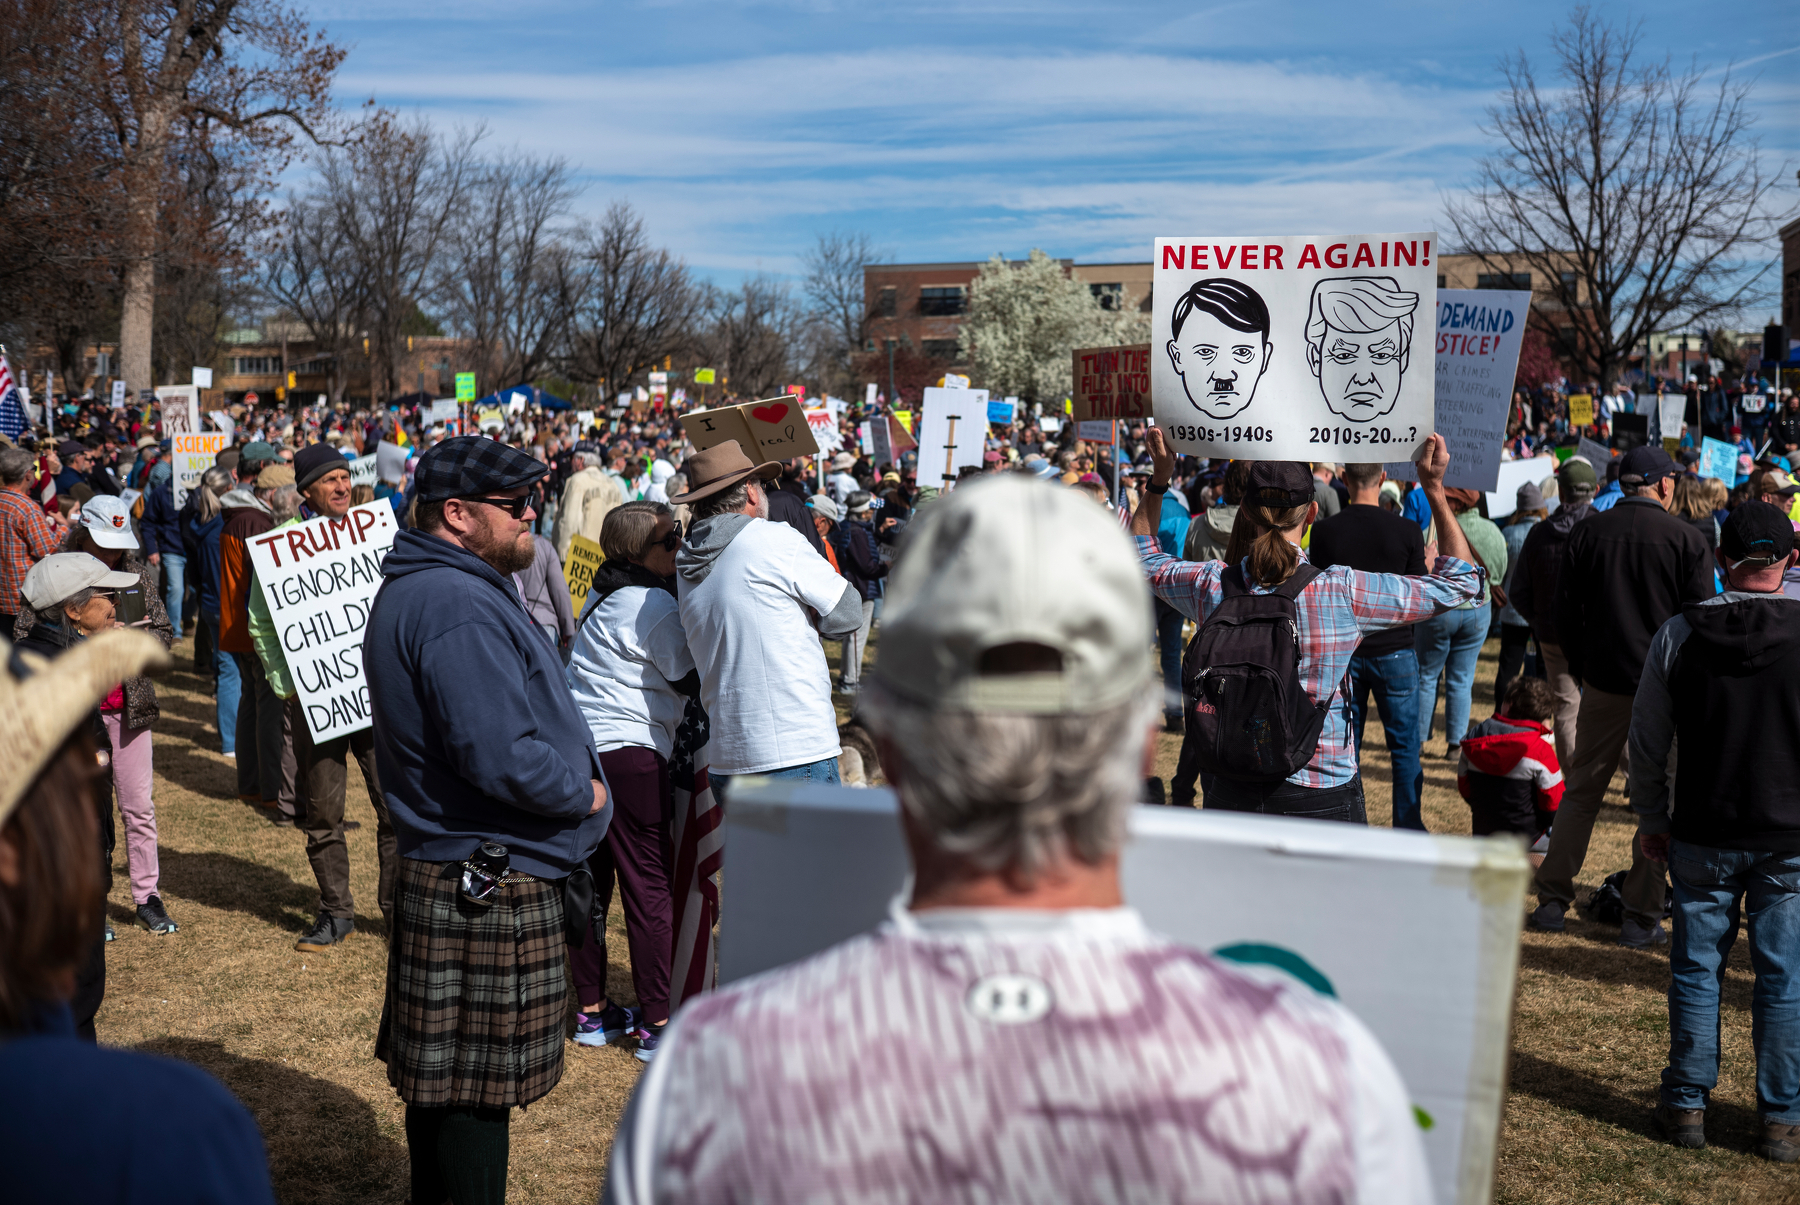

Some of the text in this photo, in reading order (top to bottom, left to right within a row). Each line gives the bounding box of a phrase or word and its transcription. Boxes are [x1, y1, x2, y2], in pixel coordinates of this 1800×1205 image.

[1162, 240, 1431, 270] NEVER AGAIN!
[1440, 302, 1514, 333] DEMAND
[1081, 350, 1148, 375] TURN THE
[1435, 360, 1491, 379] AR CRIMES
[1082, 372, 1149, 394] FILES INTO
[1435, 379, 1453, 395] MAN
[1088, 392, 1144, 417] TRIALS
[699, 417, 716, 432] I
[1438, 412, 1462, 425] RAIDS
[175, 435, 226, 454] SCIENCE
[1168, 425, 1417, 446] 1930s-1940s 2010s-20...?
[1457, 426, 1503, 442] INTERFERENCE
[188, 457, 214, 471] NOT
[255, 508, 388, 568] TRUMP:
[568, 578, 592, 599] GO
